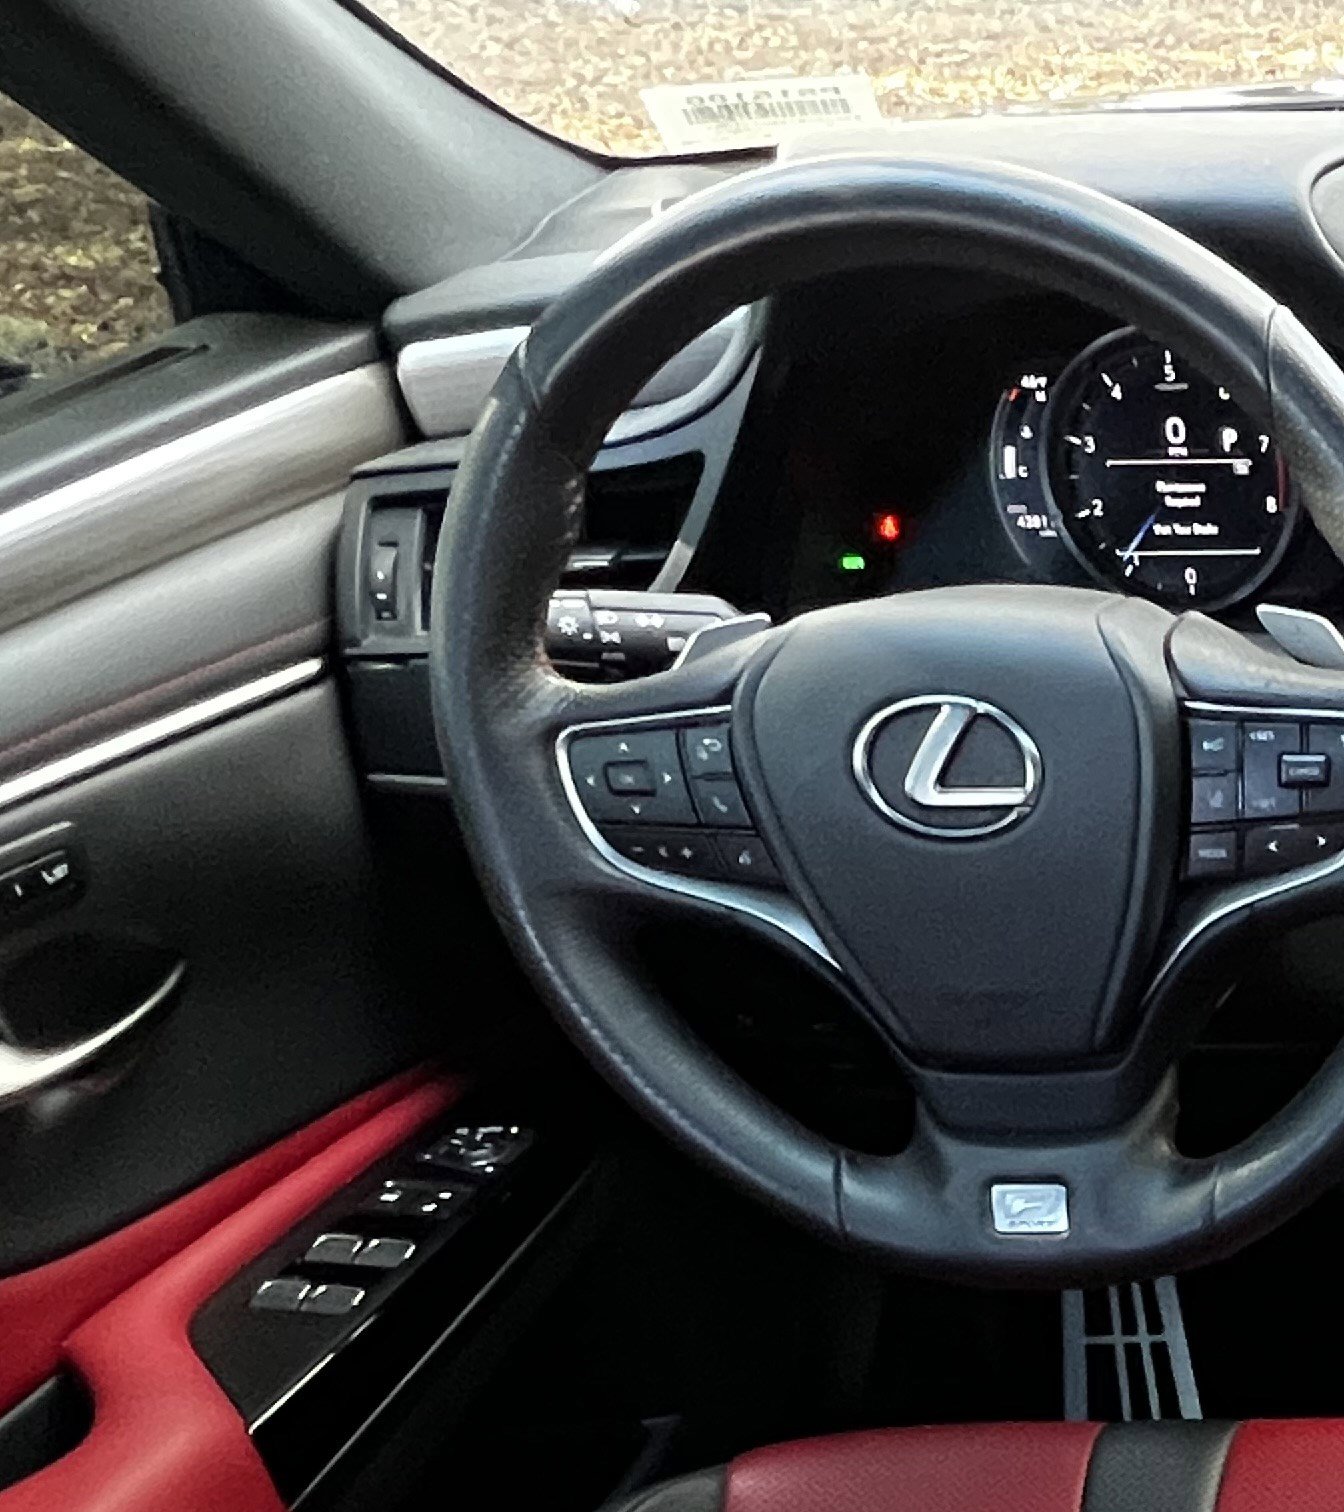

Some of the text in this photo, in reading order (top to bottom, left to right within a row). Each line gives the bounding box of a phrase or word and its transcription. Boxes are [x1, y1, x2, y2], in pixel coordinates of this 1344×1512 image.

[1164, 365, 1176, 382] 5
[1111, 383, 1122, 400] 4
[1165, 416, 1186, 444] 0
[1084, 436, 1096, 453] 3
[1222, 427, 1238, 452] P
[1258, 434, 1270, 453] 7
[1092, 499, 1103, 517] 2
[1184, 567, 1197, 584] 0
